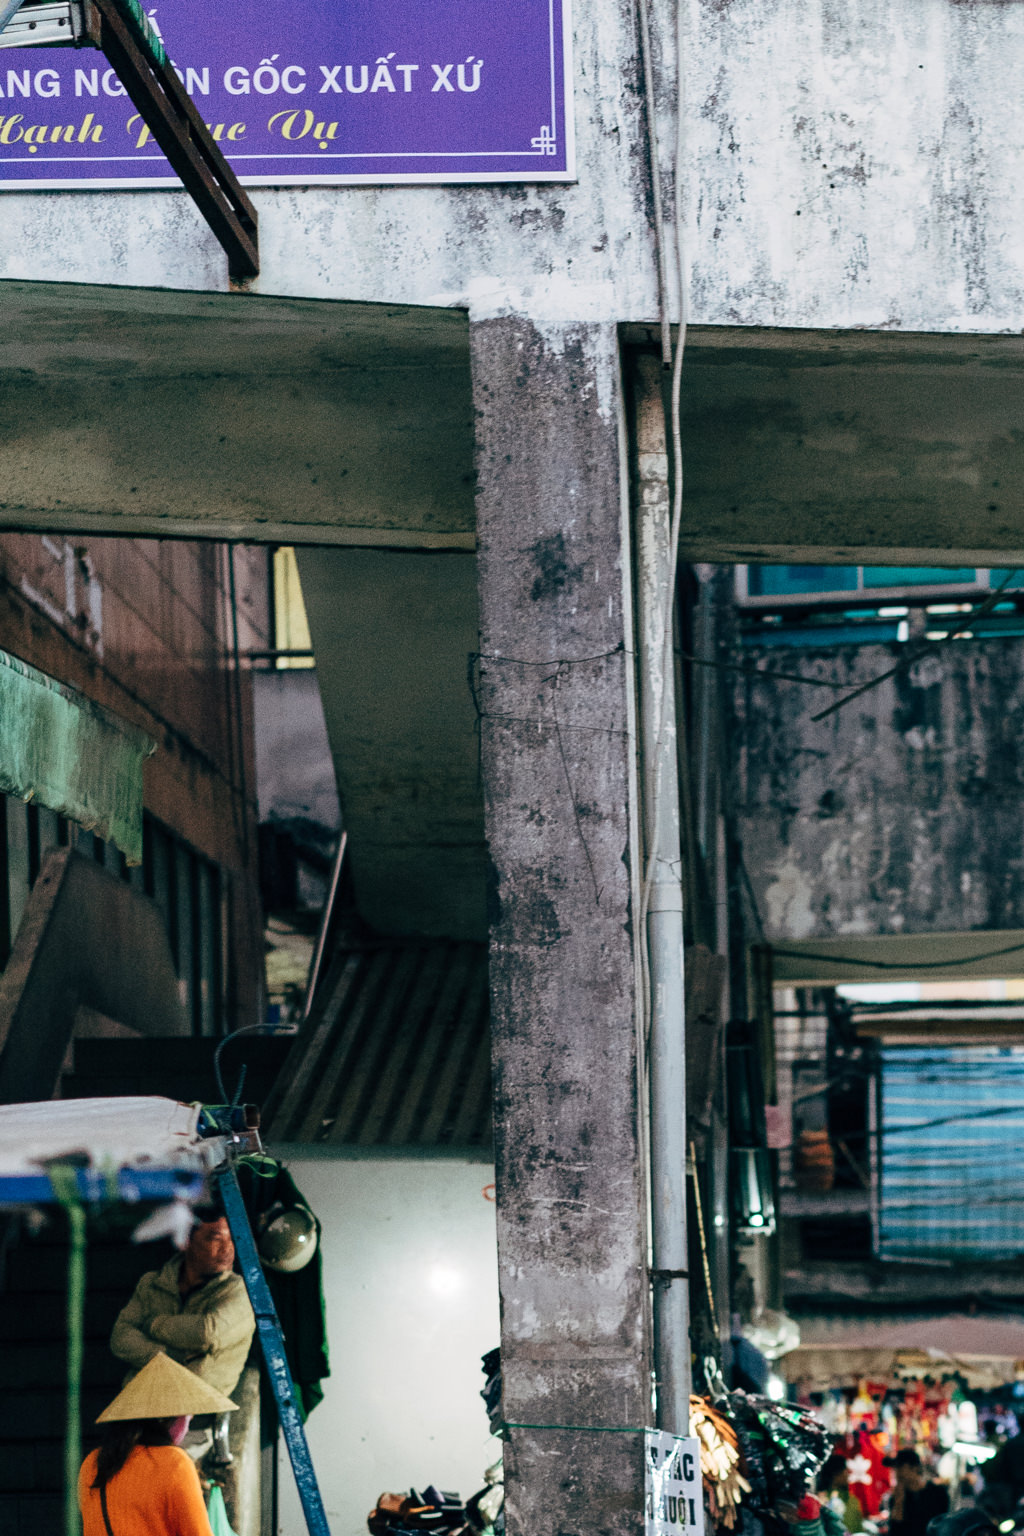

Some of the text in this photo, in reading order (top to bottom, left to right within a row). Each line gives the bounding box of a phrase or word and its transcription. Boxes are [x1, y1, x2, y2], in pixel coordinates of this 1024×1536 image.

[0, 68, 61, 98] NG
[223, 54, 307, 95] GỐC
[319, 52, 419, 94] XUẤT
[431, 58, 484, 93] XỨ
[267, 109, 342, 150] Vụ
